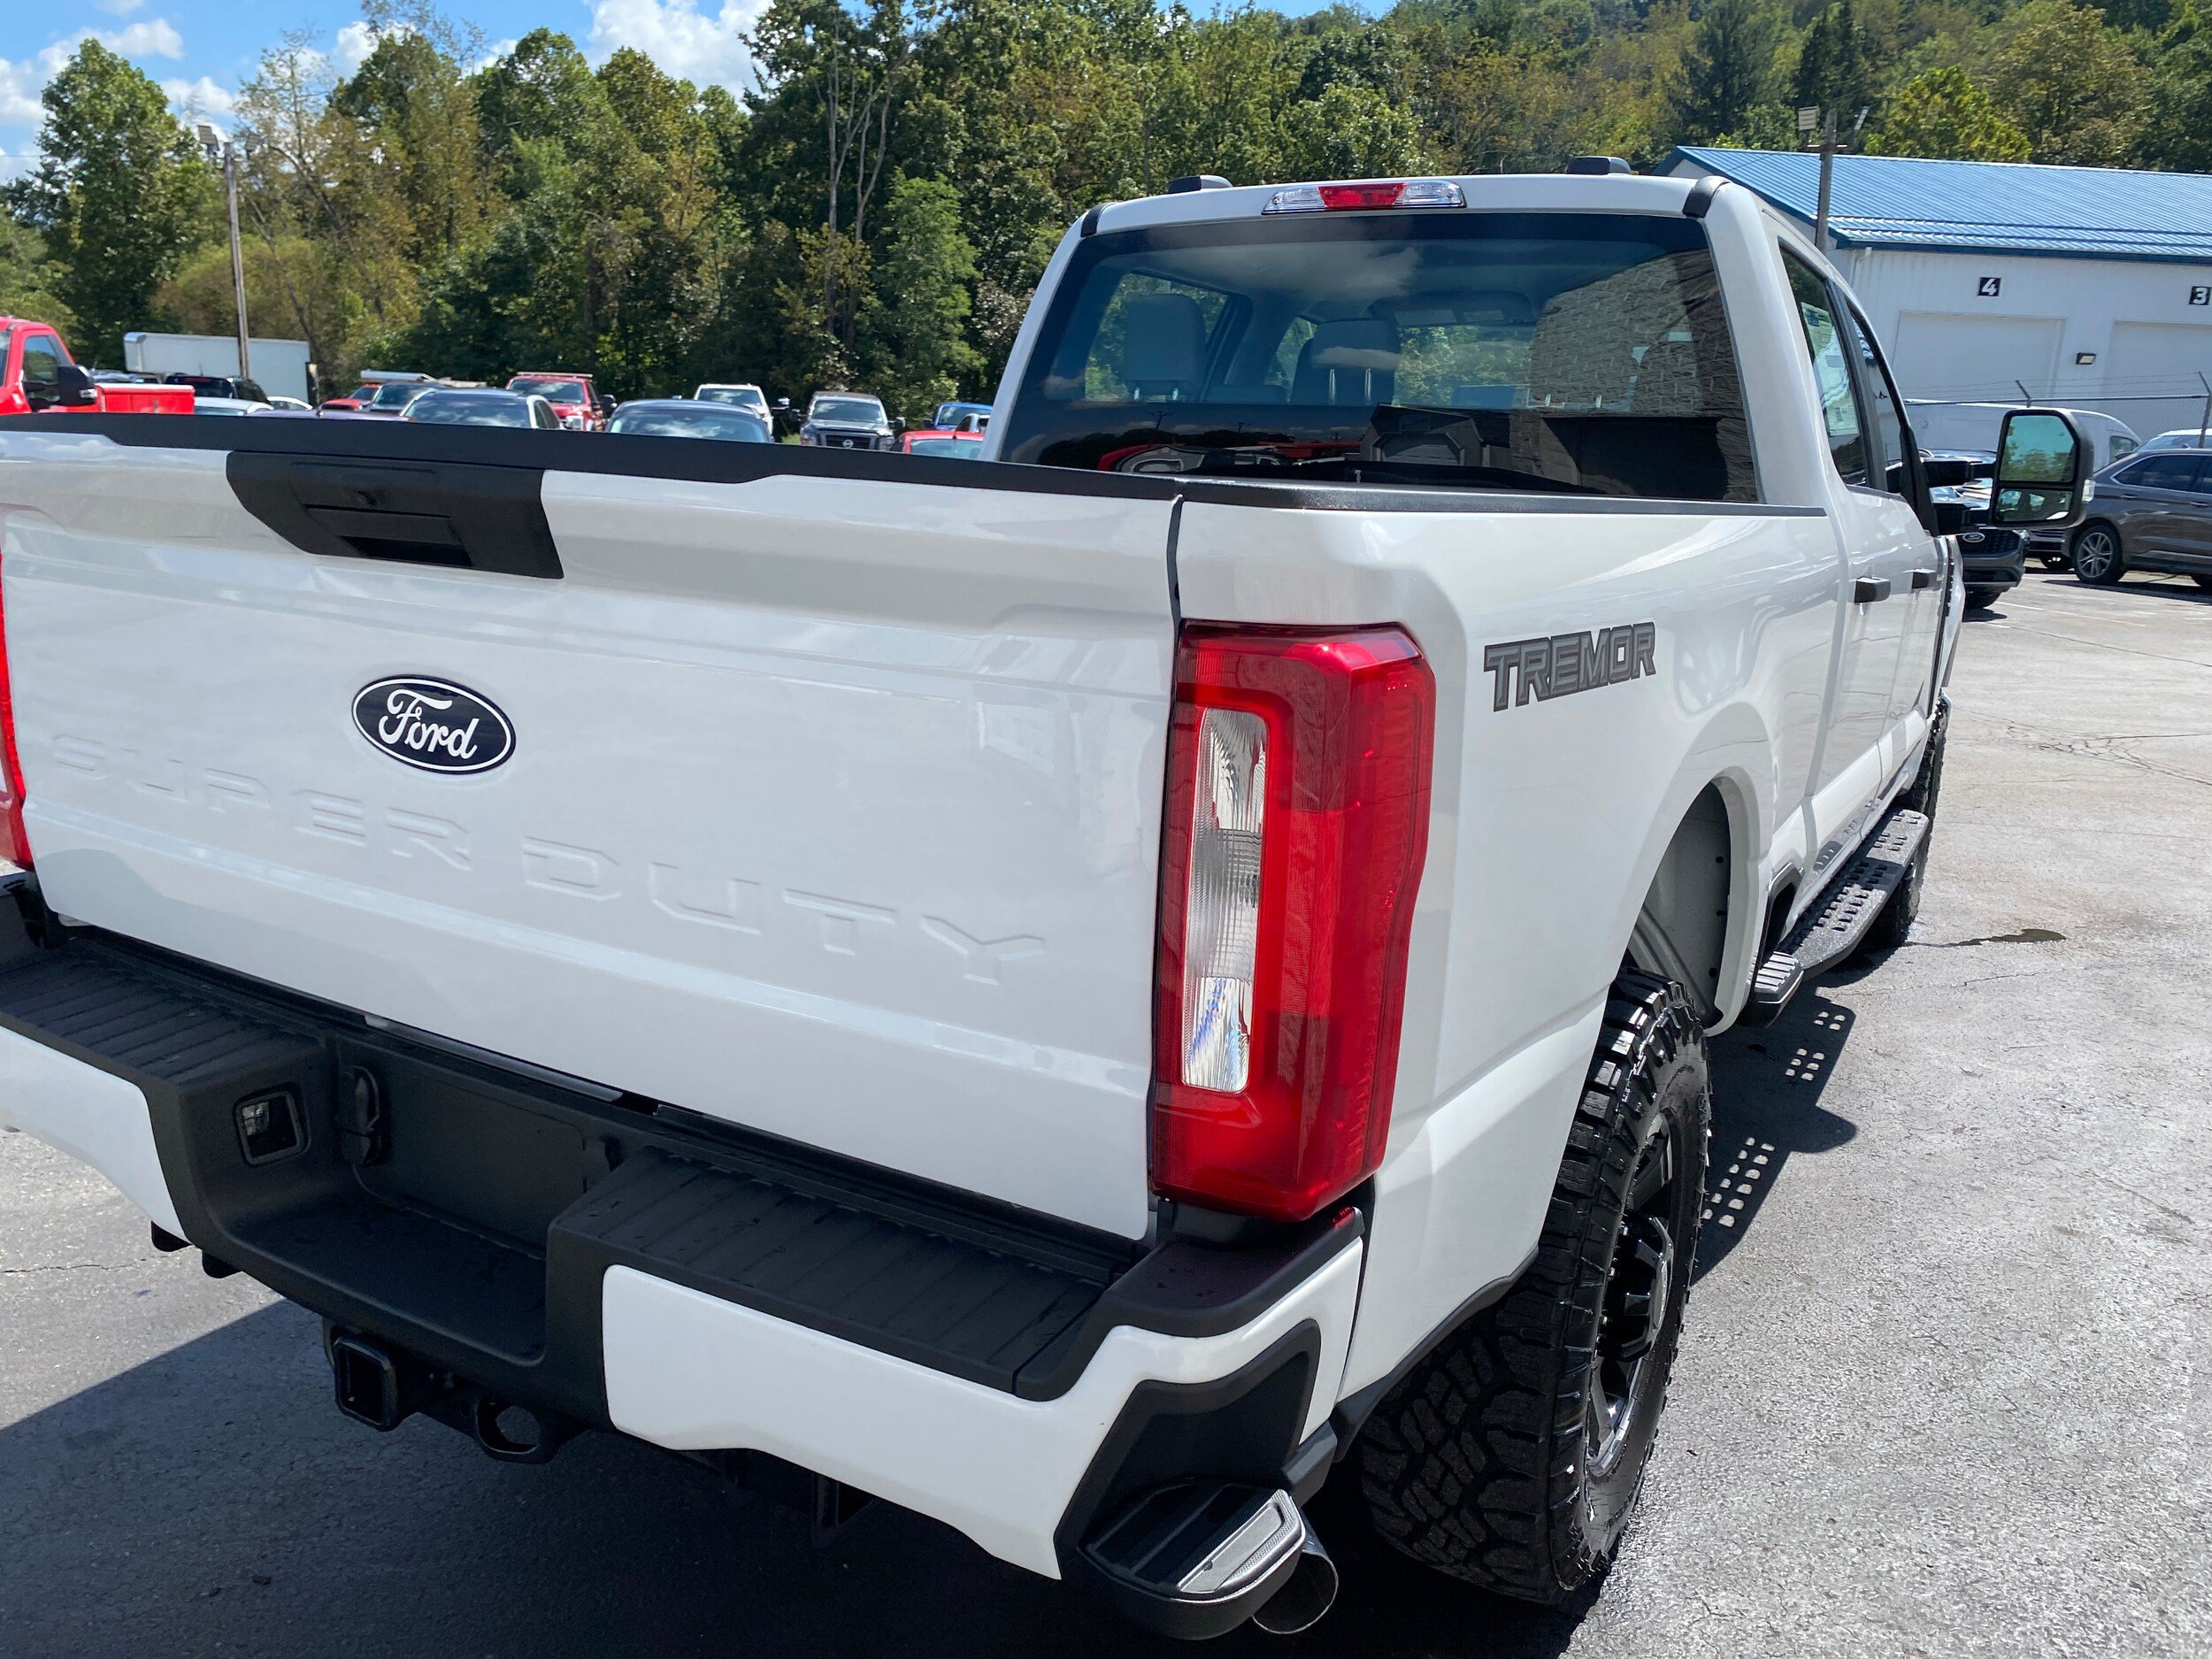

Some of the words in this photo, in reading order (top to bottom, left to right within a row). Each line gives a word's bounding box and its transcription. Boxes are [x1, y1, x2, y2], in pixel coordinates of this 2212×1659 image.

[1981, 278, 1998, 296] 4
[2193, 287, 2208, 304] 3
[1483, 621, 1656, 712] TREMOR
[378, 688, 480, 760] Ford
[50, 733, 472, 871] SUPER
[523, 835, 1047, 986] DUTY
